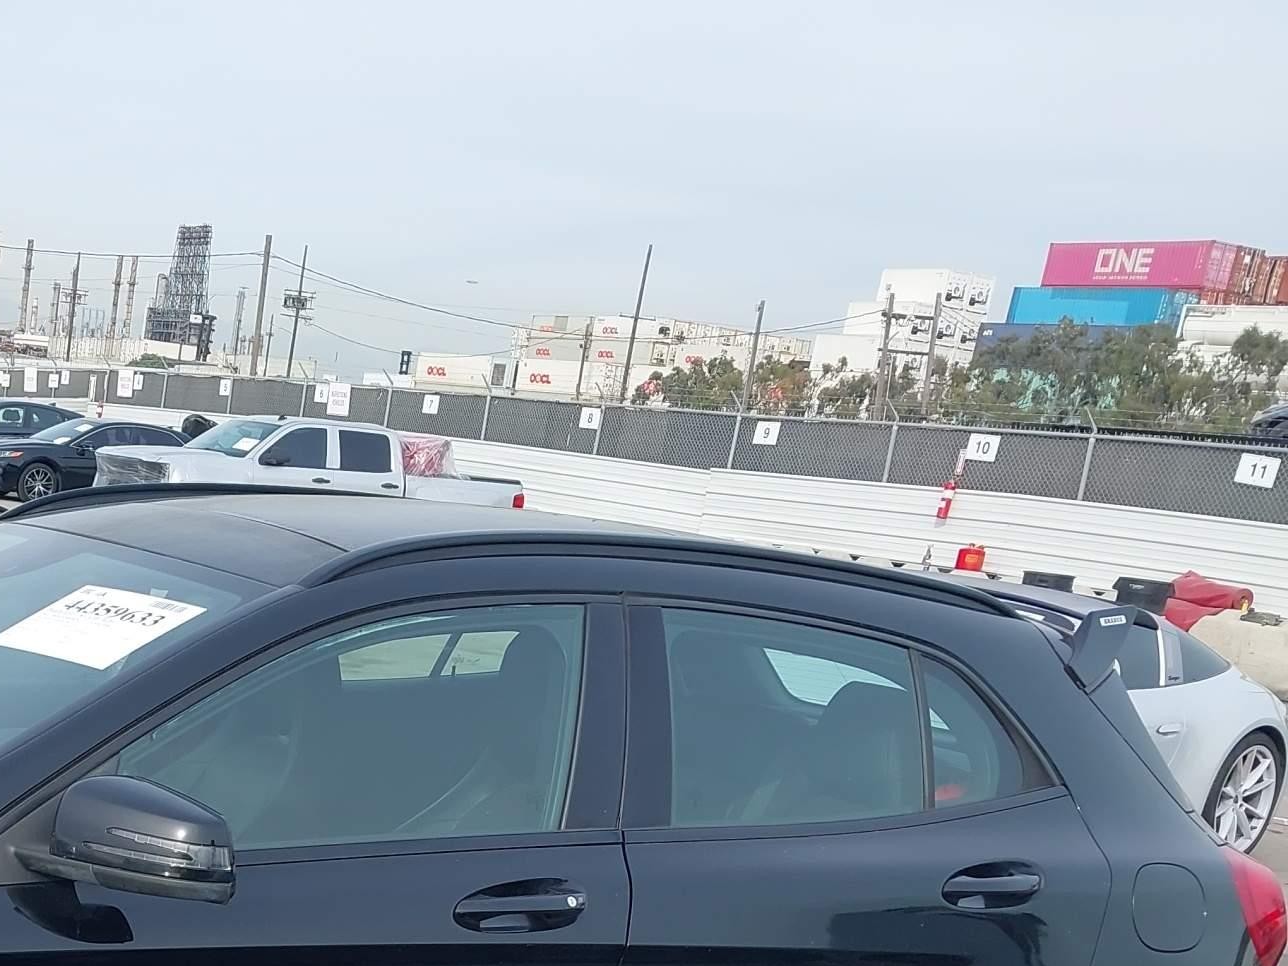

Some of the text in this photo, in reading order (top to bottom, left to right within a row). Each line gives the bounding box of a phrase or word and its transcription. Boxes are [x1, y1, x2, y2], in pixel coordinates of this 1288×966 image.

[1094, 247, 1154, 273] ONE
[535, 348, 551, 357] OOCL
[597, 350, 615, 359] OOCL
[426, 366, 447, 377] OOCL
[529, 373, 552, 384] OOCL
[763, 427, 771, 439] 9
[975, 440, 991, 455] 10
[1250, 462, 1268, 479] 11
[64, 600, 166, 627] 44359633
